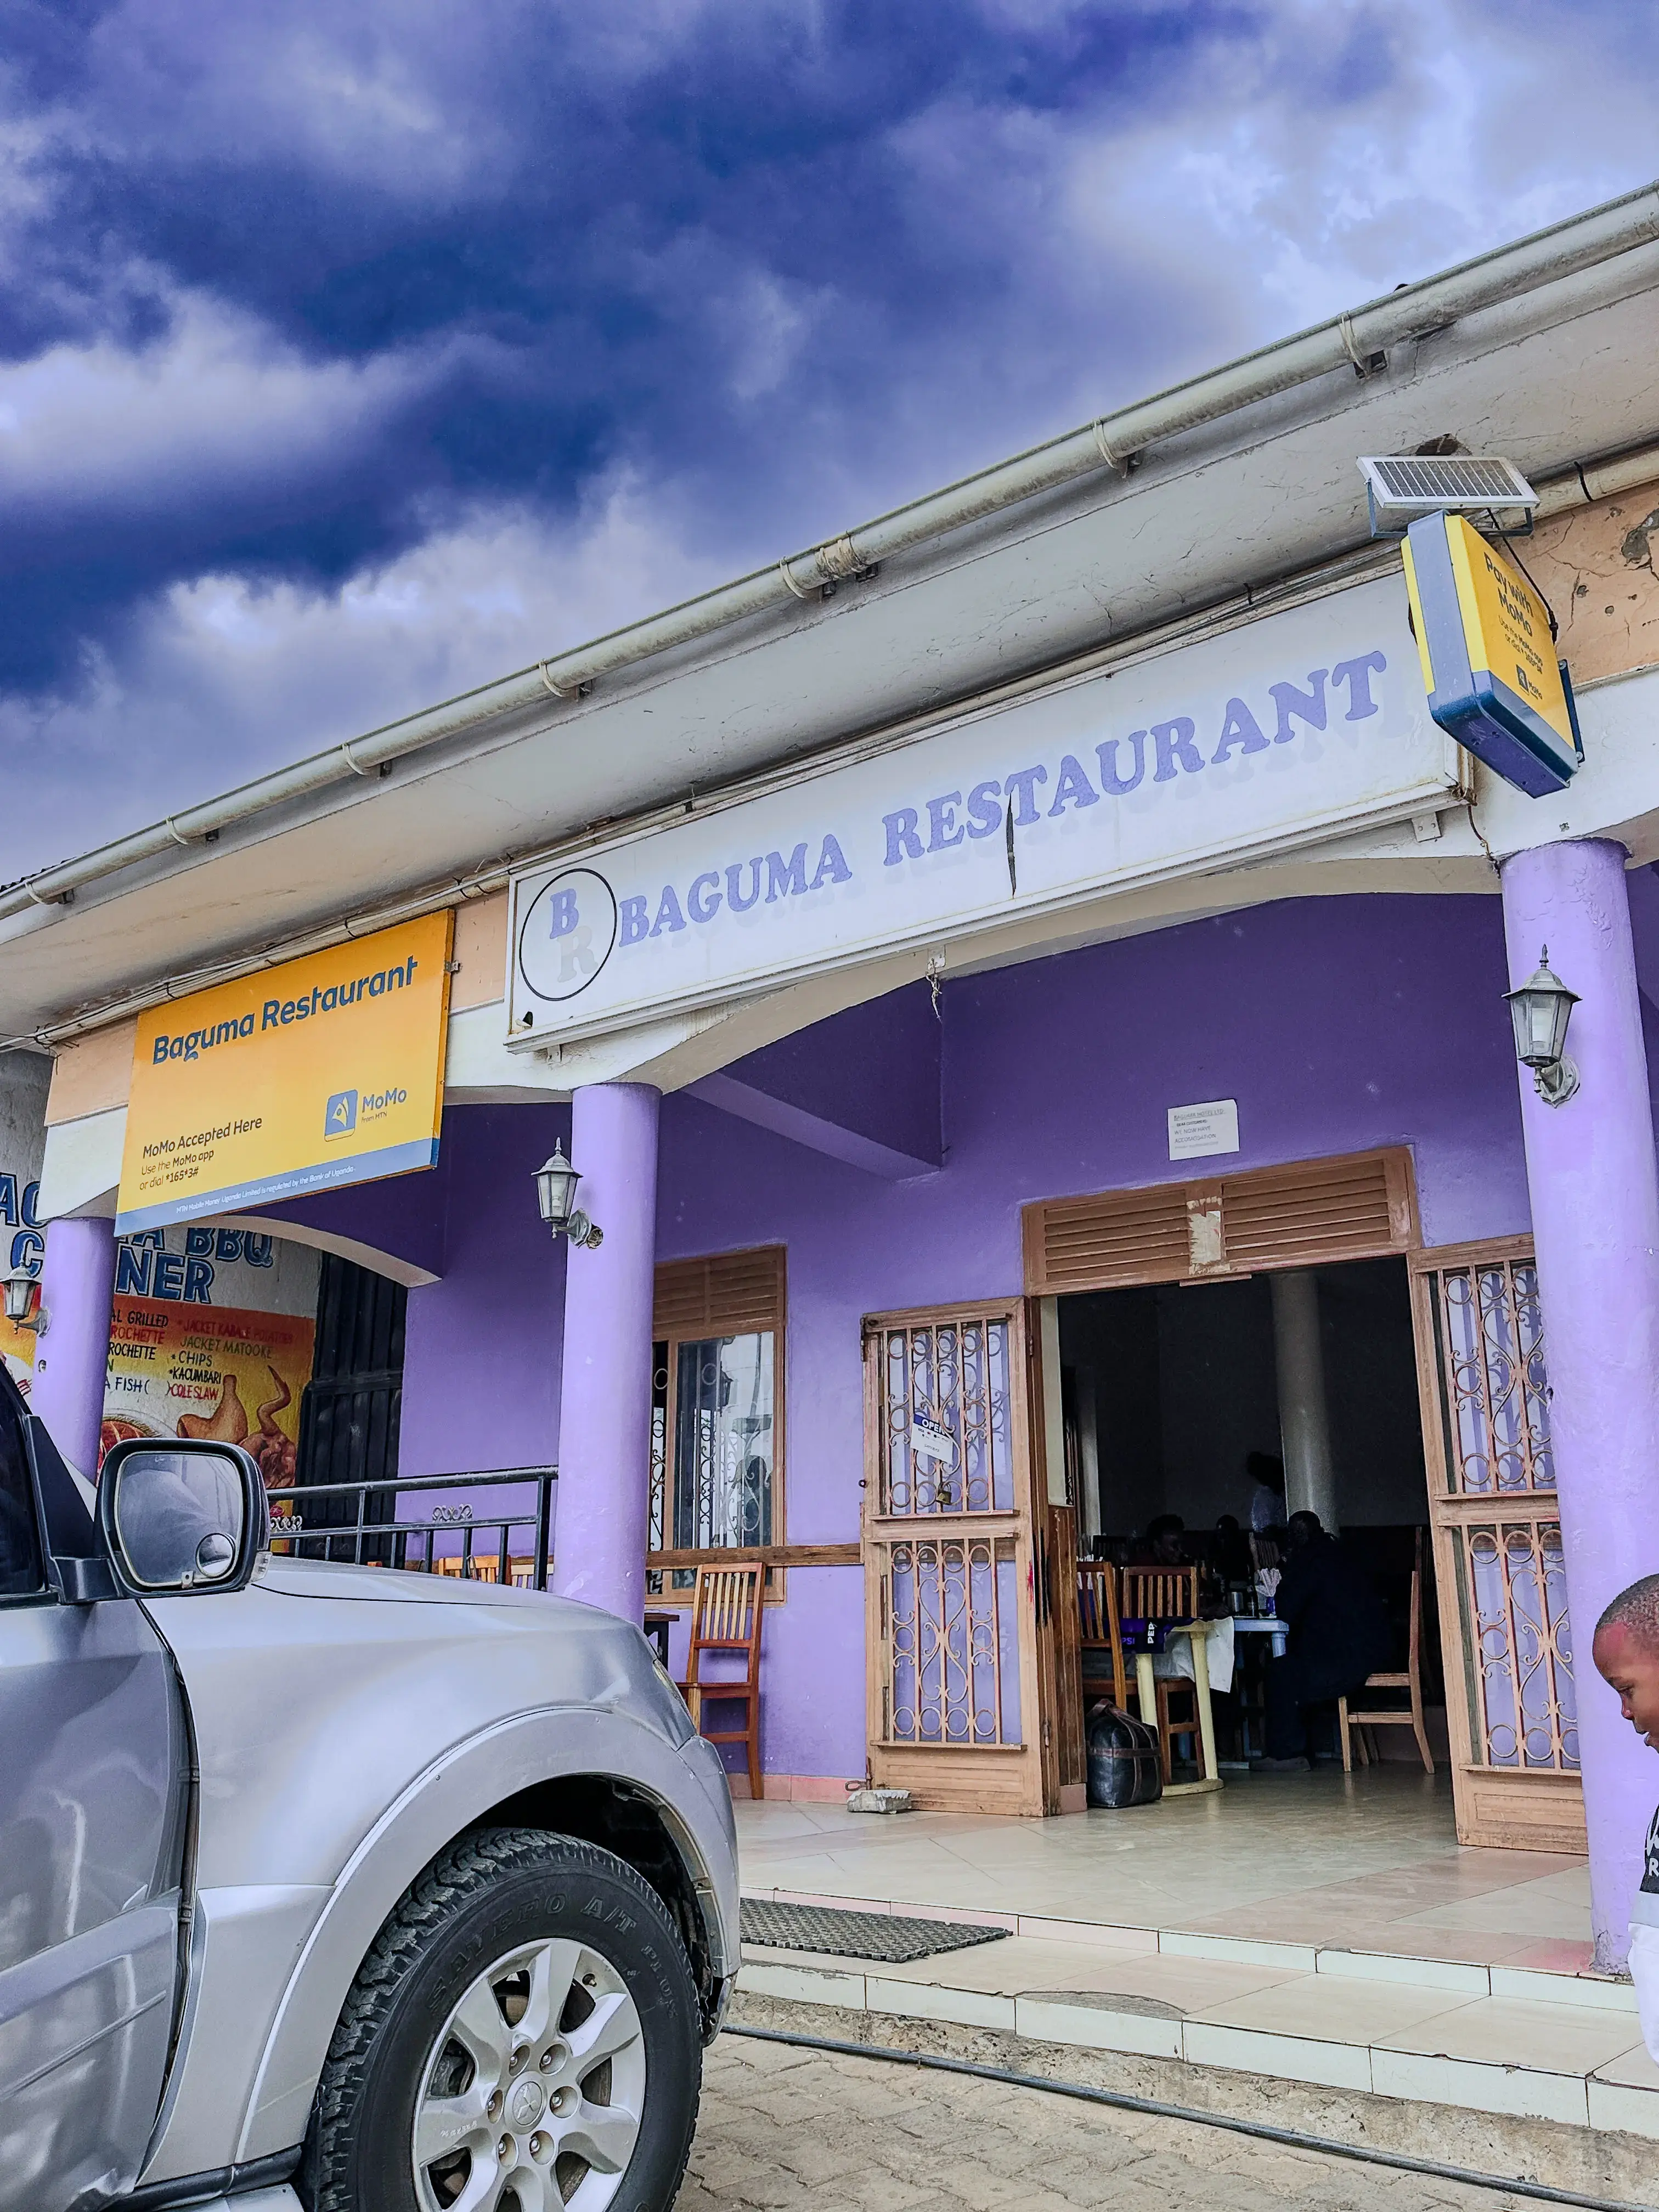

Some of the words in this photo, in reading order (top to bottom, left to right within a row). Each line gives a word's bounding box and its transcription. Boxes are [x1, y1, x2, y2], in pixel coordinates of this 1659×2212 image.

[1483, 551, 1507, 594] Pay
[1508, 580, 1534, 618] with
[1497, 586, 1533, 636] MoMo
[619, 833, 853, 947] BAGUMA
[882, 650, 1387, 867] RESTAURANT
[549, 888, 579, 940] B
[152, 1013, 255, 1065] Baguma
[261, 955, 419, 1031] Restaurant
[362, 1087, 407, 1113] MoMo
[375, 1111, 387, 1120] MTN
[143, 1139, 176, 1159] MoMo
[177, 1122, 231, 1150] Accepted
[233, 1118, 262, 1135] Here
[142, 1164, 156, 1176] Use
[157, 1160, 171, 1171] the
[172, 1153, 197, 1167] MoMo
[198, 1149, 215, 1163] app
[139, 1181, 149, 1190] or
[150, 1175, 164, 1188] dial
[185, 1227, 274, 1268] BBQ
[127, 1310, 169, 1328] GRILLED
[179, 1350, 213, 1367] CHIPS
[180, 1336, 221, 1352] JACKET
[223, 1340, 273, 1359] MATOOKE
[172, 1366, 222, 1384] KACUMBARI
[580, 1895, 638, 1937] A/T
